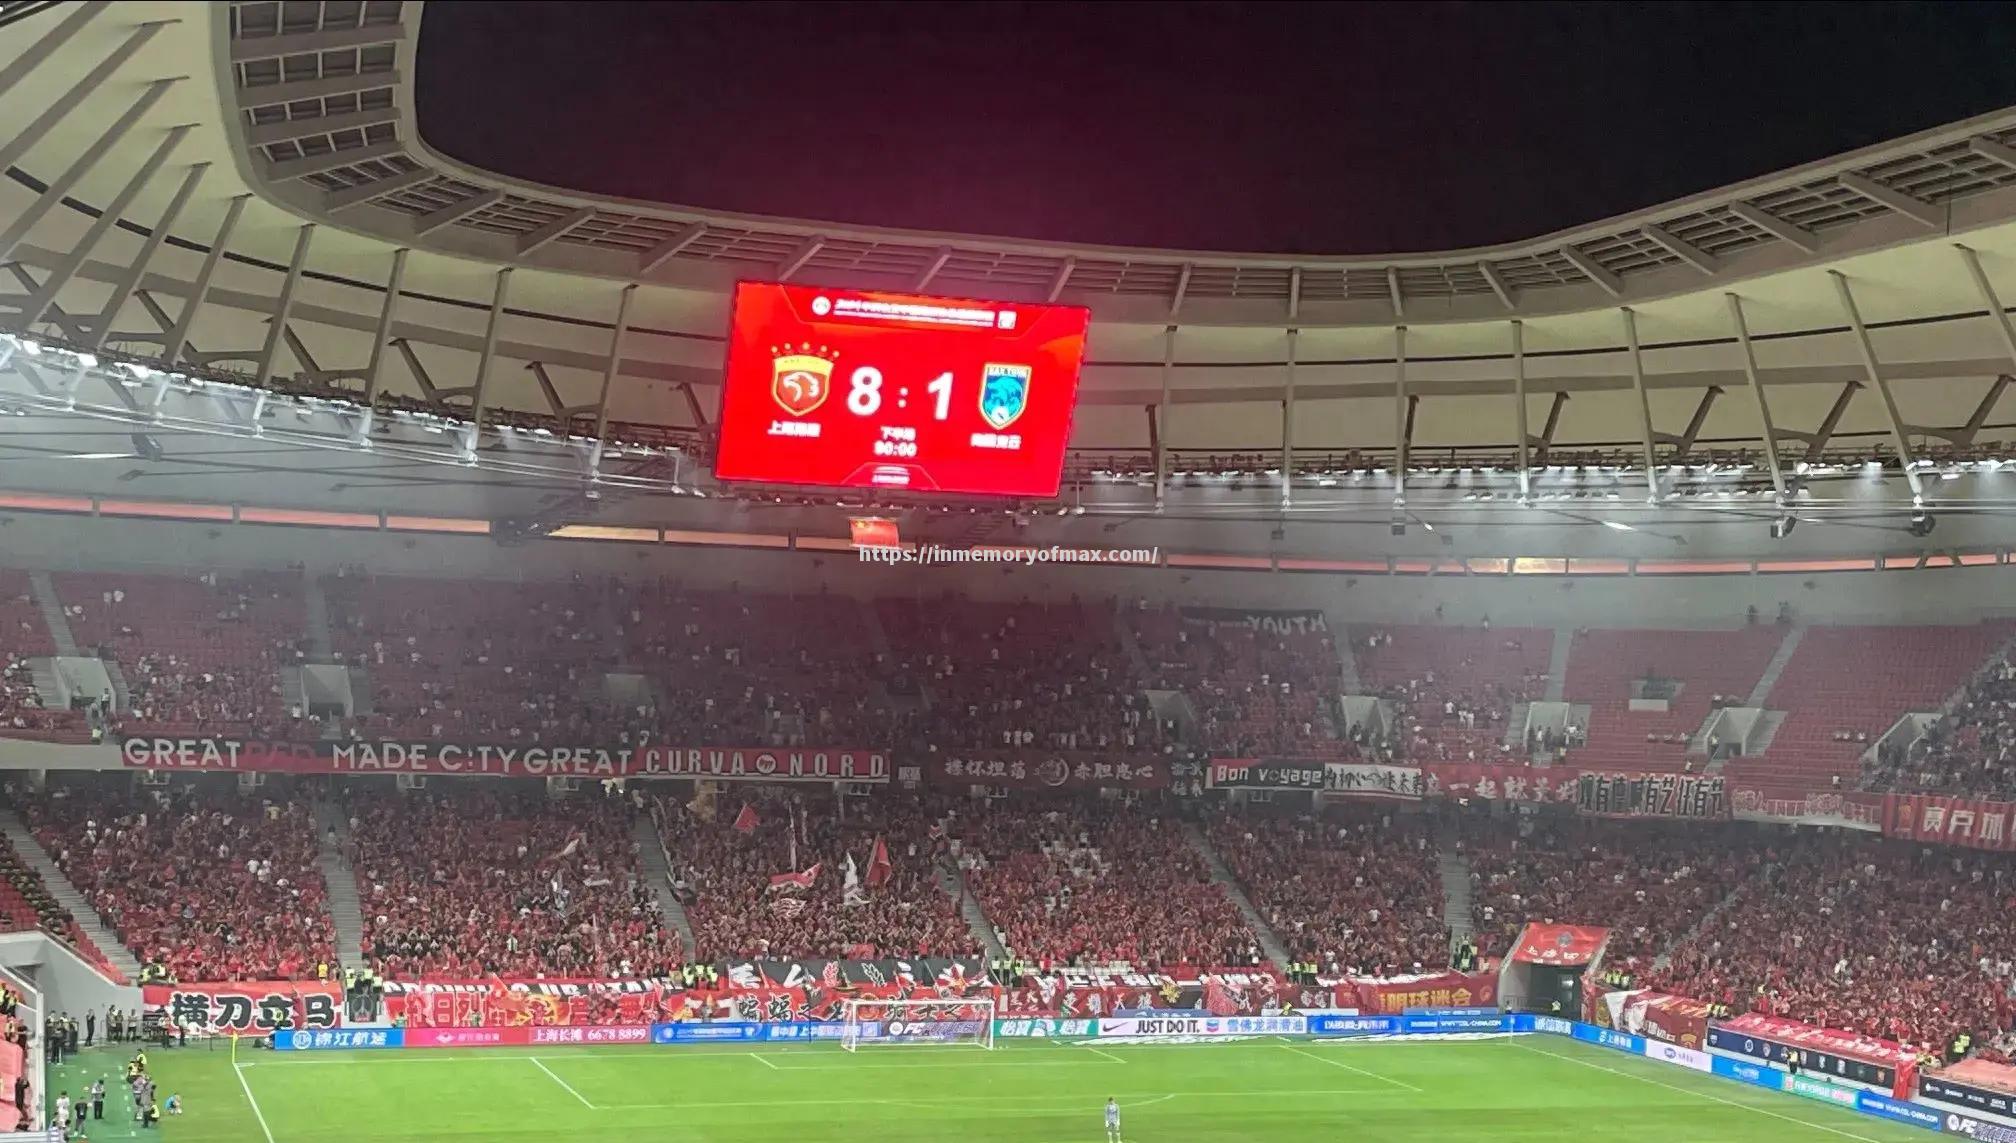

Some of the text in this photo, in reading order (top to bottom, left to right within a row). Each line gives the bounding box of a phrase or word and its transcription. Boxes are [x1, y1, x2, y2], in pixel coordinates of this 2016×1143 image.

[846, 366, 883, 416] 8
[927, 372, 954, 420] 1
[124, 737, 241, 768] GREAT
[332, 742, 428, 770] MADE
[524, 748, 632, 775] GREAT
[645, 751, 746, 775] CURVA
[789, 753, 884, 777] NORD
[1216, 765, 1249, 782] Bon
[1258, 768, 1322, 786] voyage
[171, 991, 335, 1029] 横刀立马
[588, 1029, 616, 1041] 6678
[619, 1029, 646, 1040] 8899
[1136, 1020, 1201, 1034] JUST DO IT.
